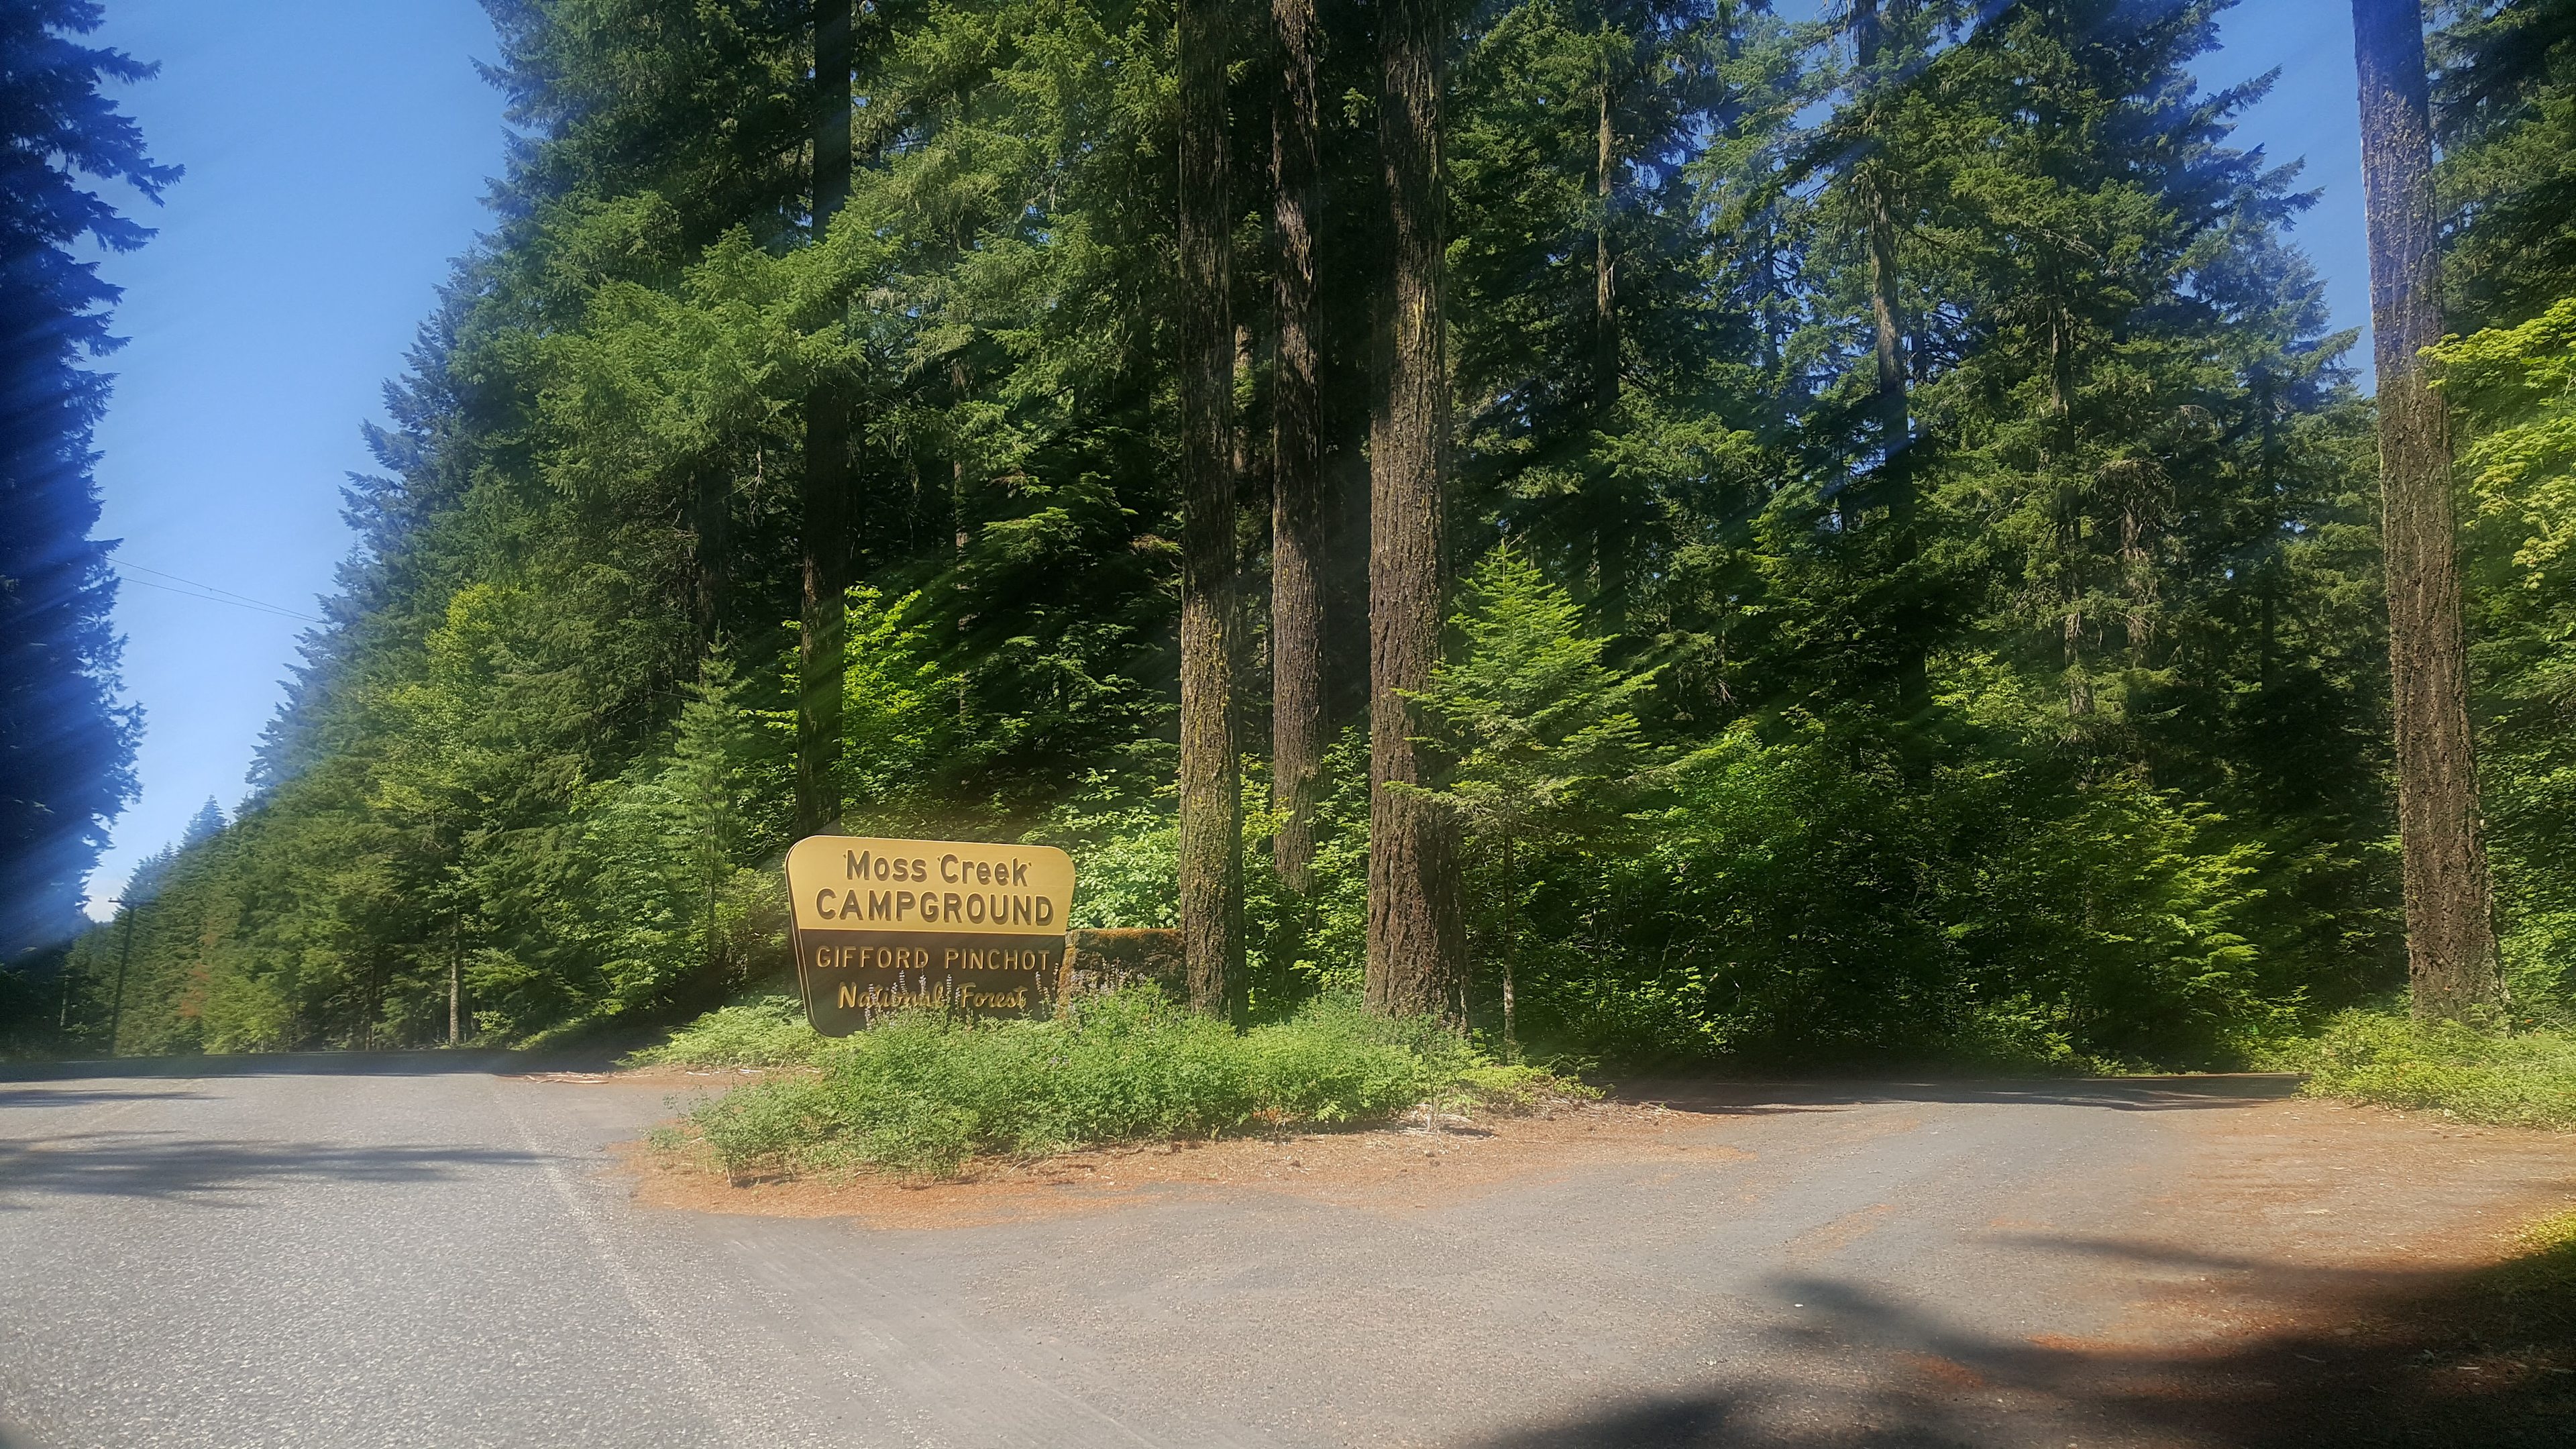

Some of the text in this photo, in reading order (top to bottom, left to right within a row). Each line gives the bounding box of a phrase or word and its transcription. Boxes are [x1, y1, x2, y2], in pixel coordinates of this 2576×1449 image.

[845, 850, 1028, 886] Moss Creek
[816, 889, 1053, 925] CAMPGROUND
[816, 946, 1051, 970] GIFFORD PINCHOT
[959, 983, 1028, 1008] Forest
